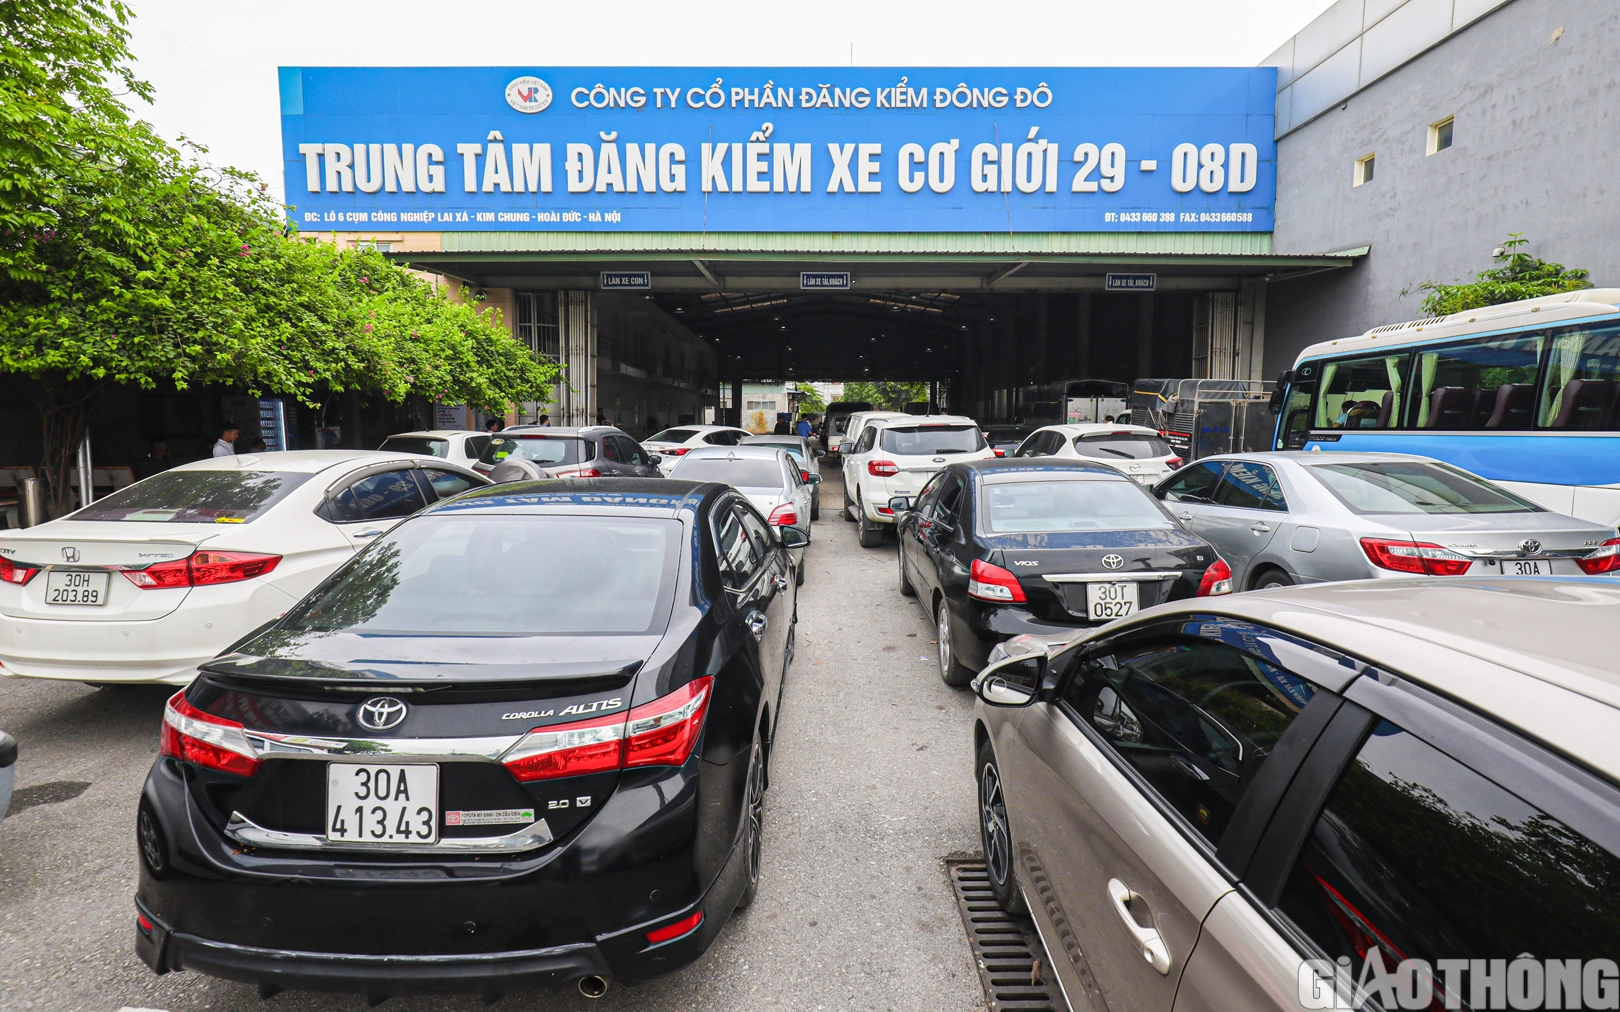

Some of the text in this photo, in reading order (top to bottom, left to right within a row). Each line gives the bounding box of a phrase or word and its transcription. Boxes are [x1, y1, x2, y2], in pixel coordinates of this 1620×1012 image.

[570, 76, 1053, 109] CÔNG TY CỔ PHẦN ĐĂNG KIỂM ĐÔNG ĐÔ
[298, 143, 446, 193] TRUNG
[456, 130, 553, 193] TÂM
[565, 131, 687, 193] ĐĂNG
[700, 122, 812, 193] KIỂM
[826, 143, 882, 193] XE
[897, 138, 960, 193] CƠ
[970, 126, 1059, 193] GIỚI
[1071, 142, 1126, 193] 29
[1170, 142, 1258, 193] 08D
[304, 212, 321, 222] ĐC:
[324, 210, 336, 222] LÔ
[338, 212, 344, 222] 6
[346, 212, 368, 224] CỤM
[371, 210, 397, 222] CÔNG
[400, 211, 436, 224] NGHIỆP
[437, 212, 453, 222] LAI
[455, 210, 469, 222] XÁ
[476, 212, 495, 222] KIM
[498, 212, 530, 222] CHUNG
[537, 211, 560, 222] HOÀI
[562, 211, 582, 222] ĐỨC
[588, 211, 601, 222] HÀ
[604, 210, 621, 224] NỘI
[1104, 212, 1118, 222] ĐT:
[1120, 212, 1141, 222] 0433
[1142, 212, 1158, 222] 660
[1159, 212, 1175, 222] 388
[1180, 212, 1199, 222] FAX:
[608, 276, 644, 285] LÀN XE CON
[1515, 562, 1540, 575] 30A
[65, 573, 91, 588] 30H
[52, 589, 99, 603] 203.89
[1098, 585, 1126, 600] 30T
[1093, 602, 1133, 618] 0527
[501, 697, 622, 720] COROLLA ALTIS
[354, 768, 410, 802] 30A
[548, 799, 569, 809] 2.0
[331, 805, 433, 840] 413.43
